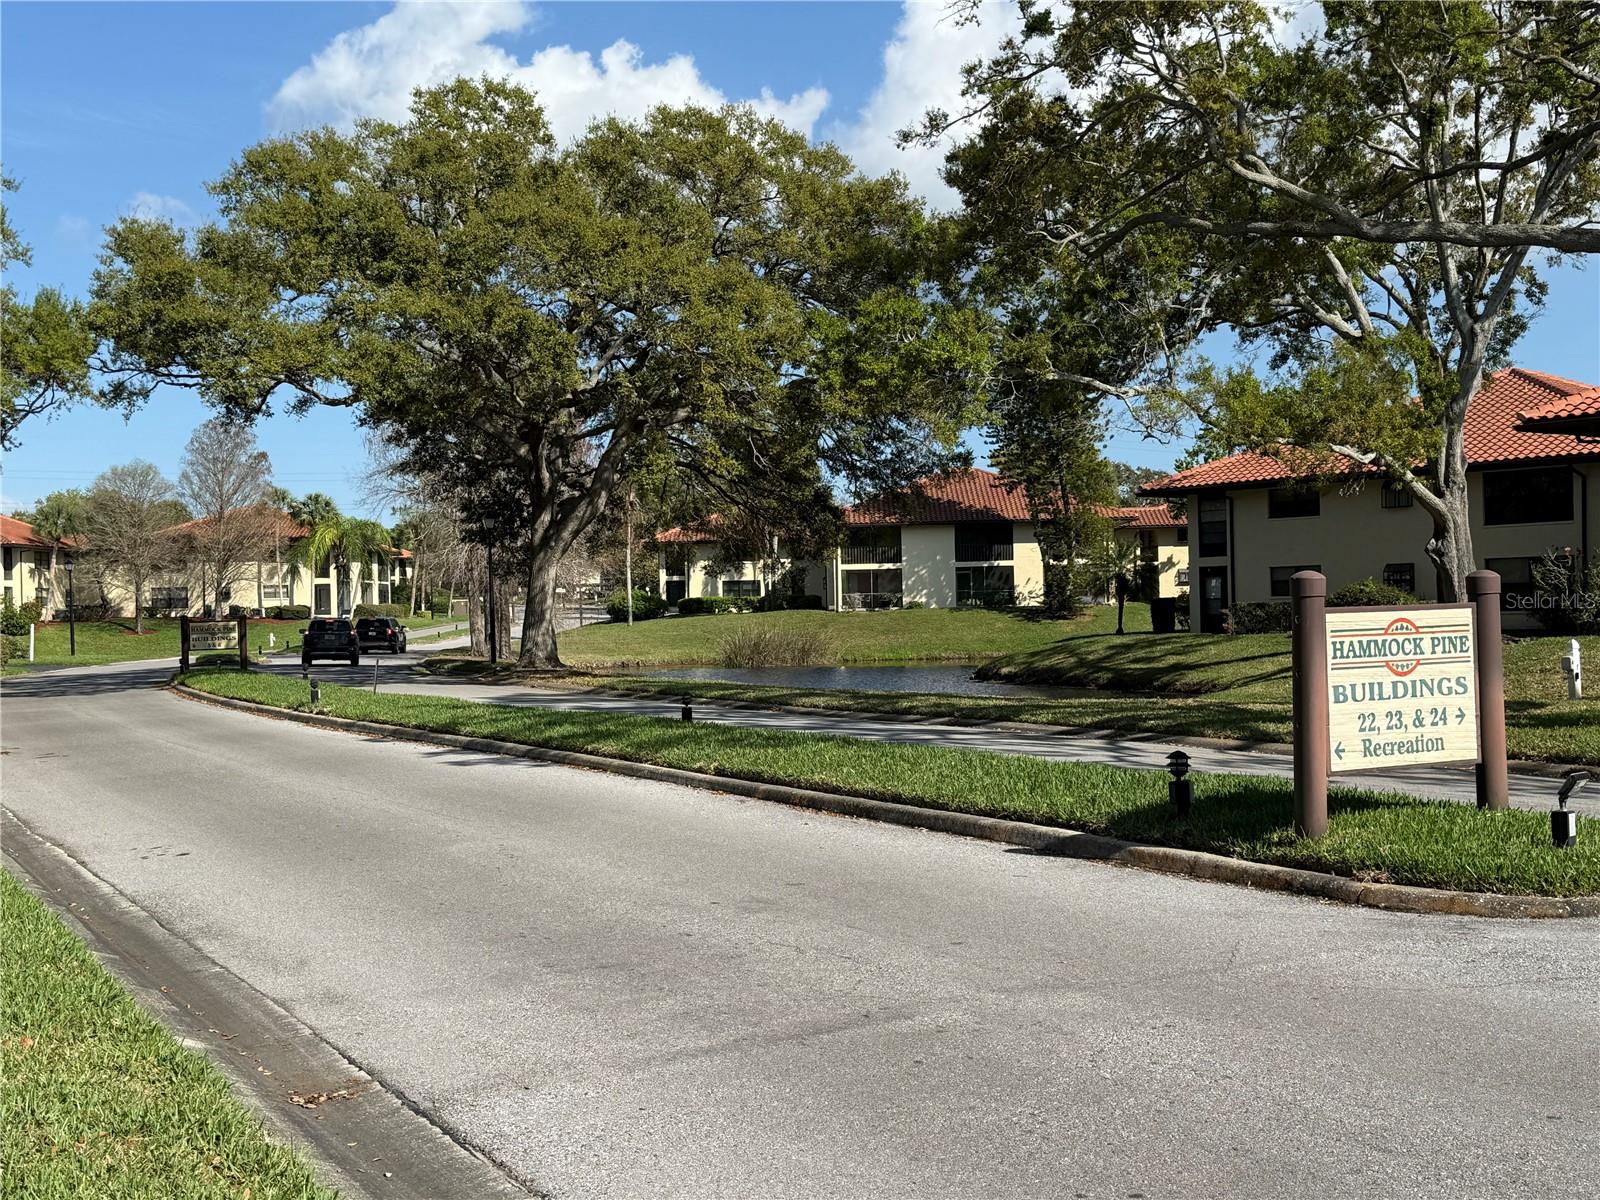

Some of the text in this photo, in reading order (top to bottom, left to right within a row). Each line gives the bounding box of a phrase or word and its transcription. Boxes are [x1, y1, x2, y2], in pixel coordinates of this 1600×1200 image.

[1331, 635, 1470, 660] HAMMOCK PINE
[1332, 676, 1468, 704] BUILDINGS
[1357, 706, 1448, 735] 22, 23, & 24
[1361, 734, 1445, 758] Recreation
